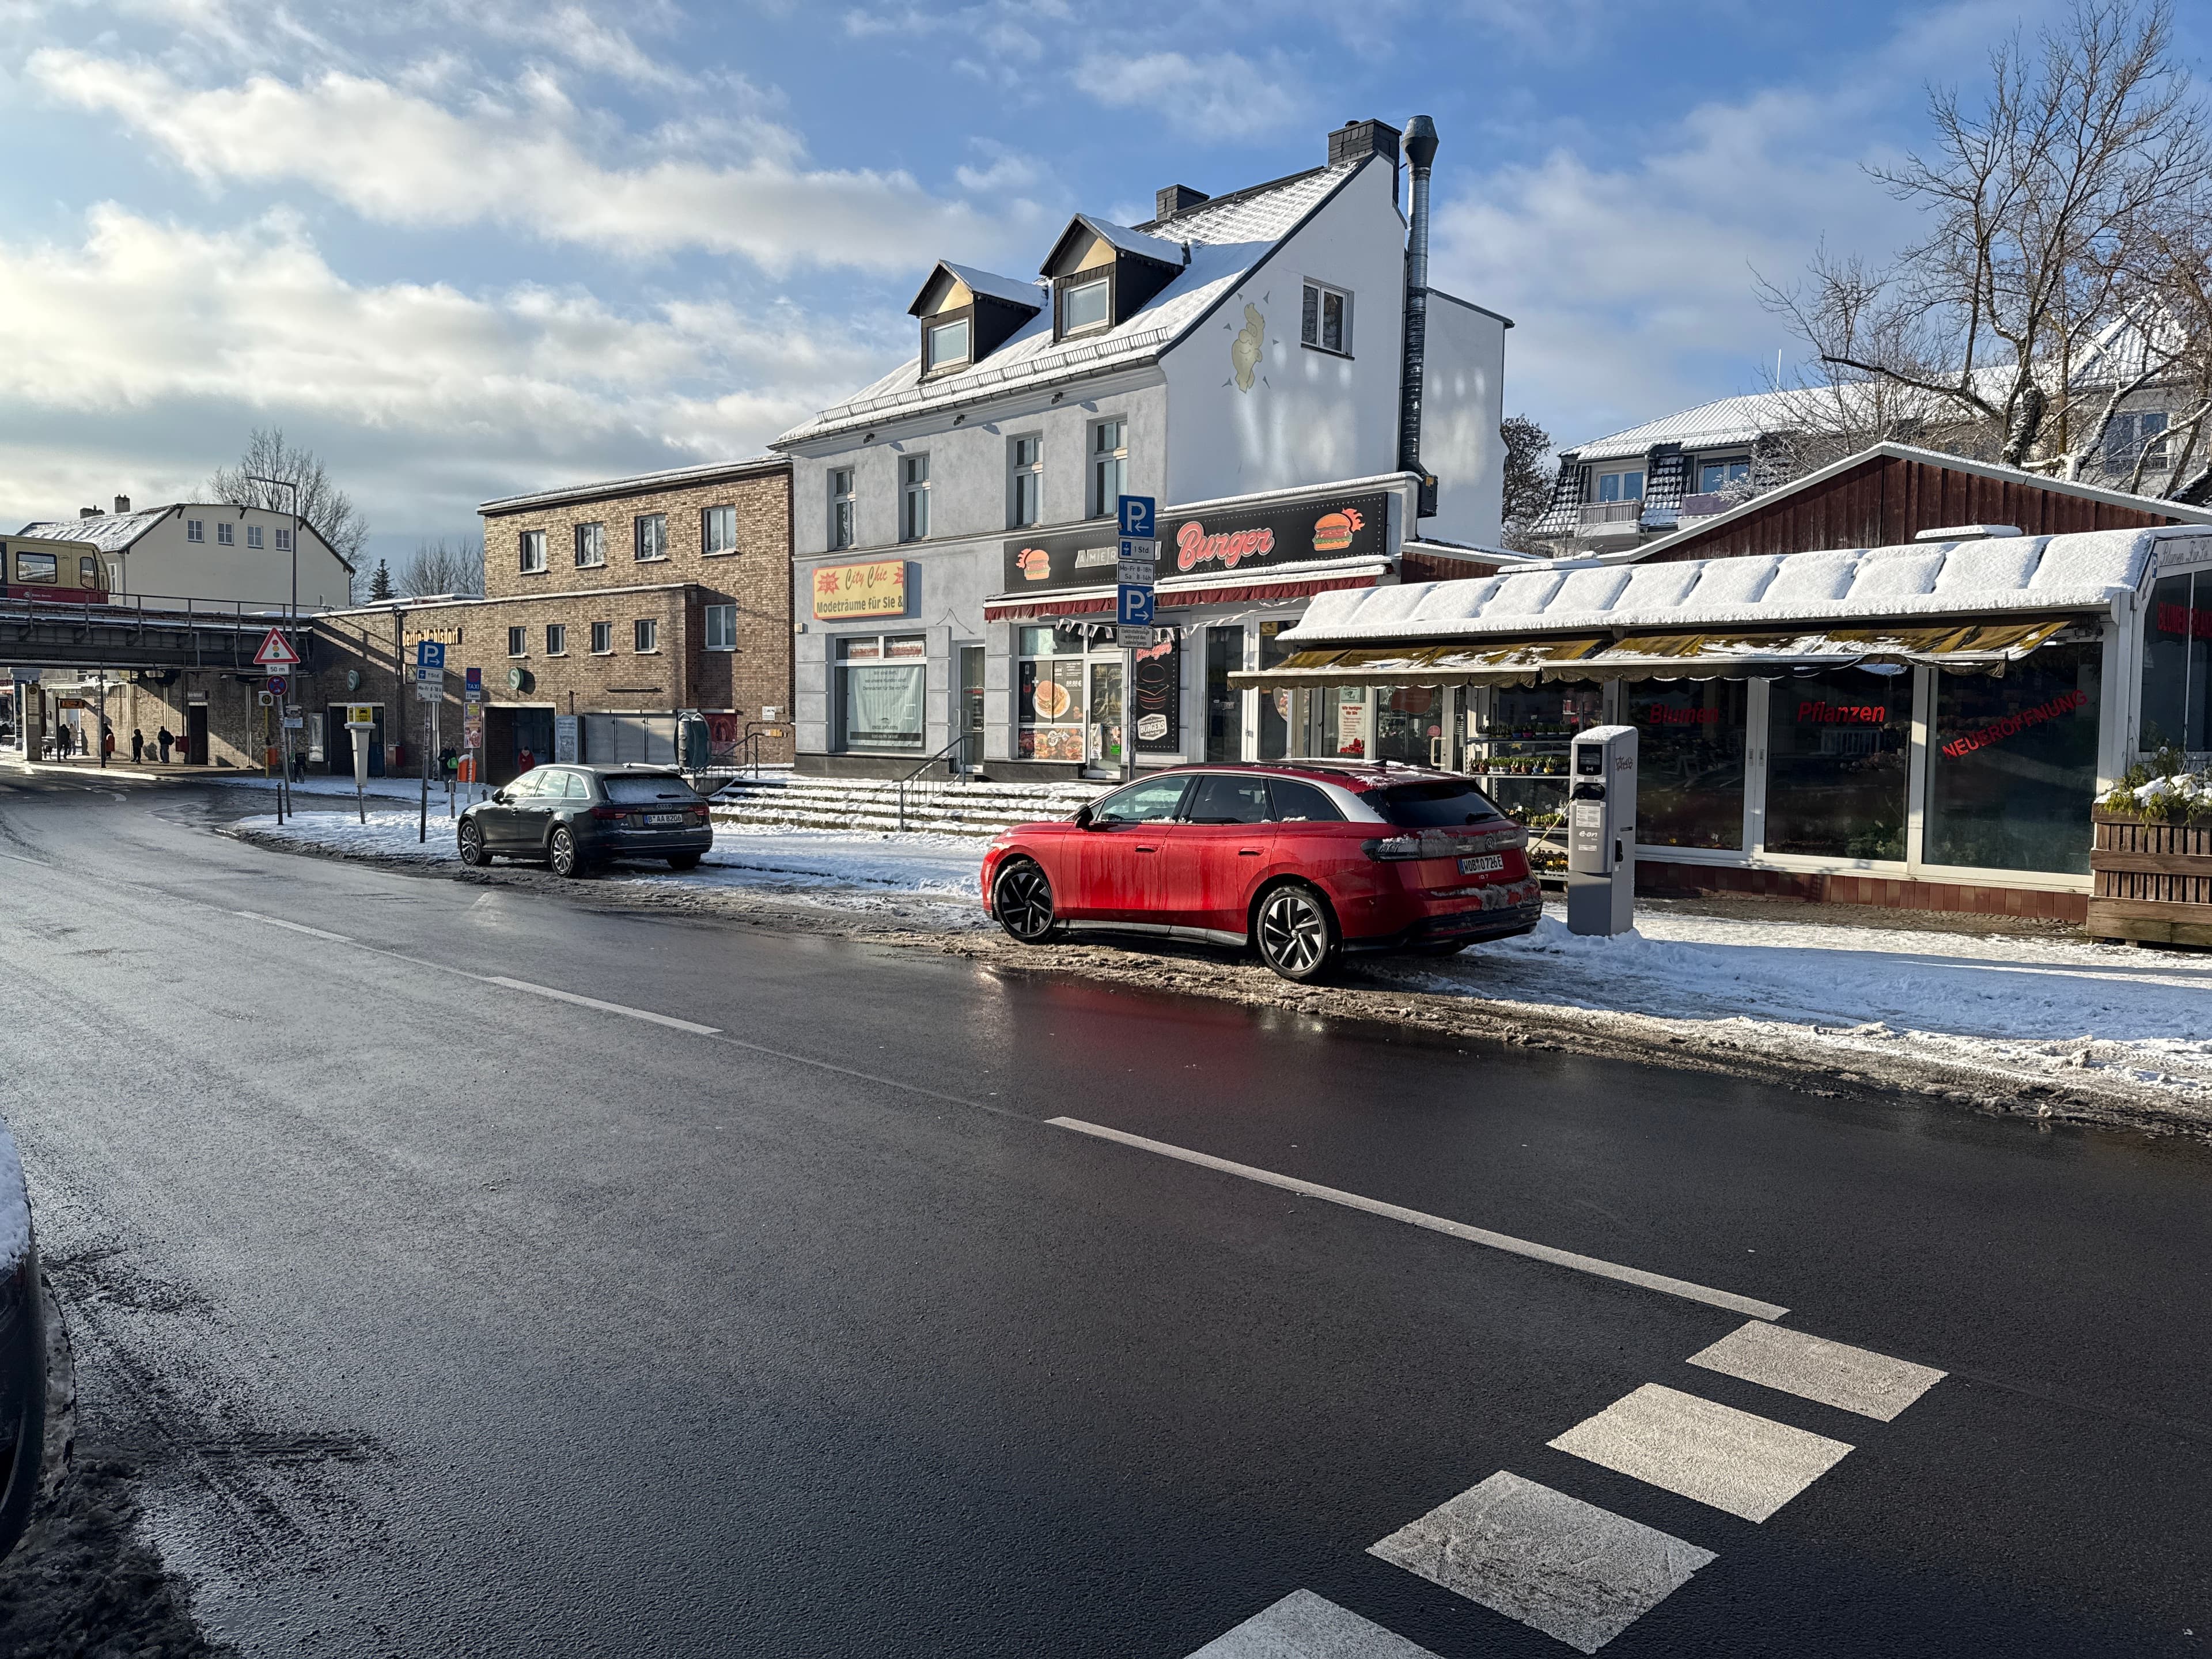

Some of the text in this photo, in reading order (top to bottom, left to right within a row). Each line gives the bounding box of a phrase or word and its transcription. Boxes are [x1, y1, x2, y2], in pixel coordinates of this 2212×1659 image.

[1127, 501, 1146, 532] P
[1177, 521, 1275, 571] Burger
[845, 568, 864, 590] City
[867, 565, 888, 589] Chic
[817, 595, 903, 613] Modeträume für Sie &
[1126, 590, 1145, 620] P
[423, 645, 438, 664] P
[1649, 704, 1719, 724] Blumen
[1797, 702, 1885, 722] Pflanzen
[1140, 721, 1165, 733] BURGERS
[1941, 690, 2088, 760] NEUERÖFFNUNG
[666, 814, 681, 822] 8206
[1463, 859, 1477, 872] WOB
